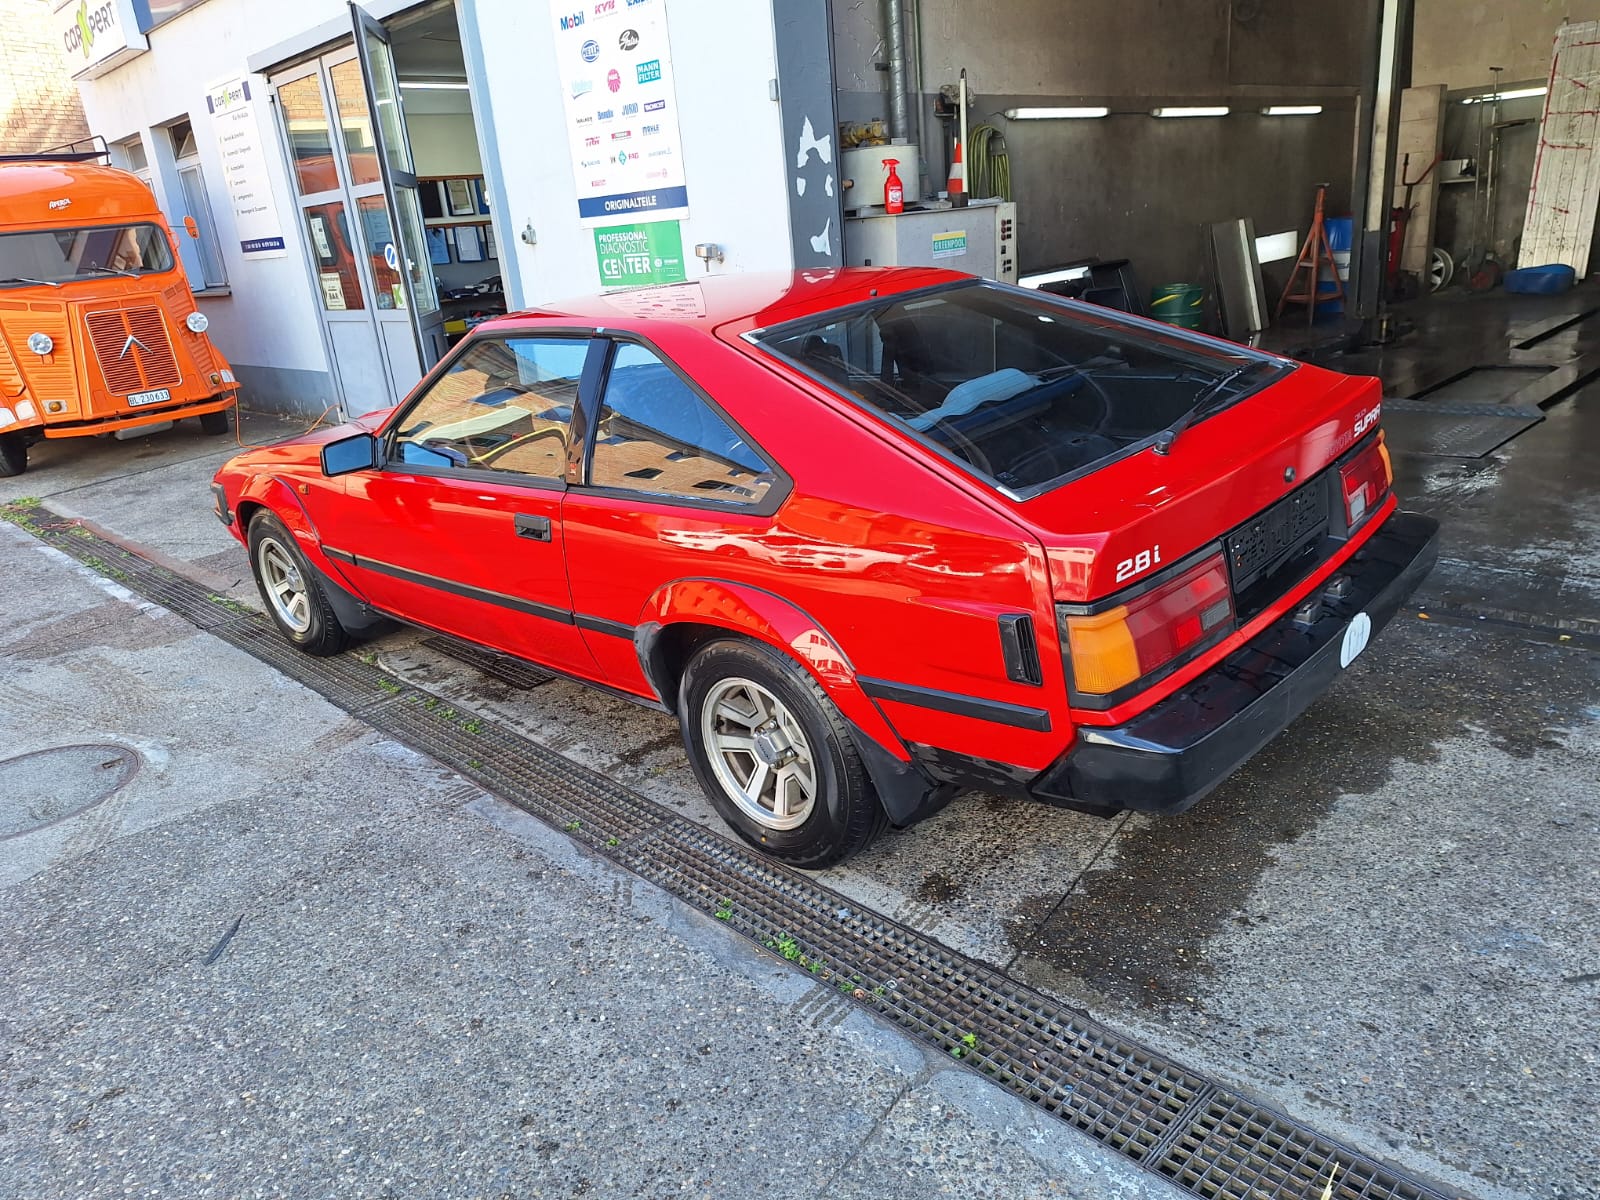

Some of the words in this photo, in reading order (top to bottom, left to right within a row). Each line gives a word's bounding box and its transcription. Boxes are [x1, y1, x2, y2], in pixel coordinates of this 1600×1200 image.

[560, 11, 585, 31] Mobil
[637, 61, 659, 73] MANN
[639, 70, 660, 82] FILTER
[605, 195, 657, 211] ORIGINALTEILE
[598, 231, 648, 243] PROFESSIONAL
[934, 238, 964, 250] GREENPOOL
[600, 240, 649, 254] DIAGNOSTIC
[603, 256, 651, 276] CENTER
[1353, 403, 1381, 438] SUPRA
